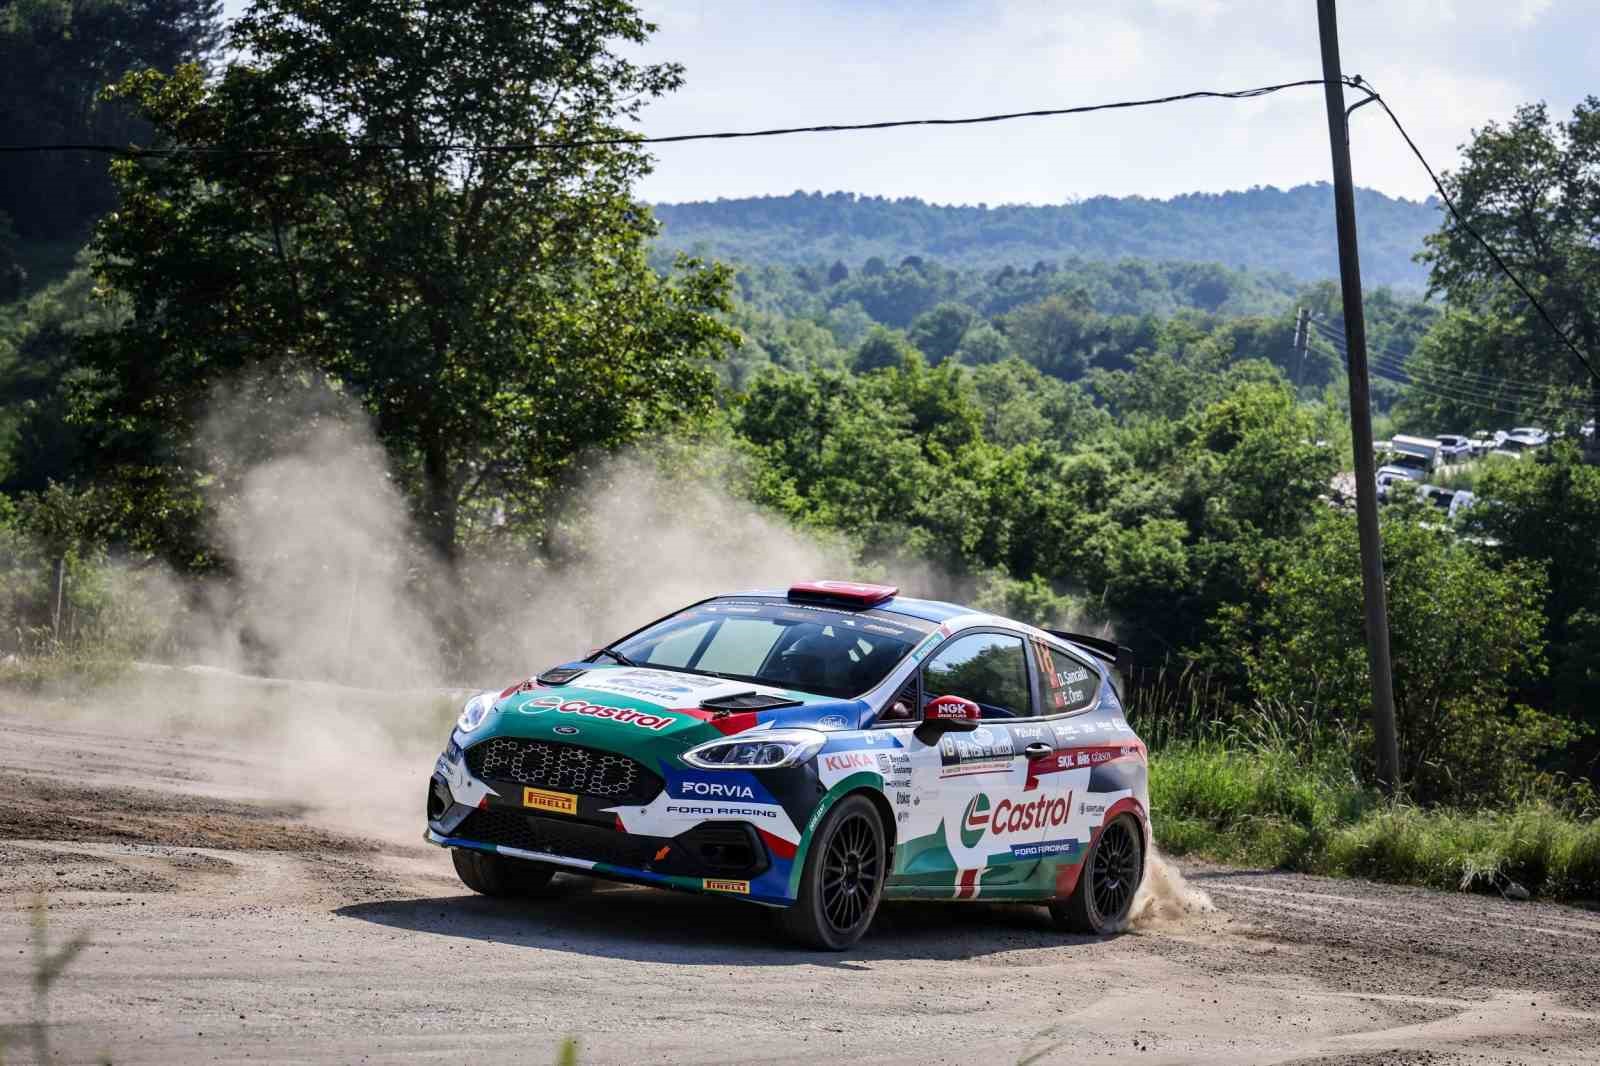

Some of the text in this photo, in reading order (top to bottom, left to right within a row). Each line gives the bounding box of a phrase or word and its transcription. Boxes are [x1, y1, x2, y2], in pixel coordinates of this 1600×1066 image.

[558, 700, 675, 731] Castrol
[938, 703, 967, 714] NGK
[825, 754, 873, 771] KUKA
[682, 781, 754, 799] FORVIA
[528, 791, 574, 810] PIRELLI
[666, 806, 777, 818] FORD RACING
[991, 790, 1073, 835] Castrol
[1015, 844, 1070, 857] FORD RACING
[706, 880, 746, 892] PIRELLI
